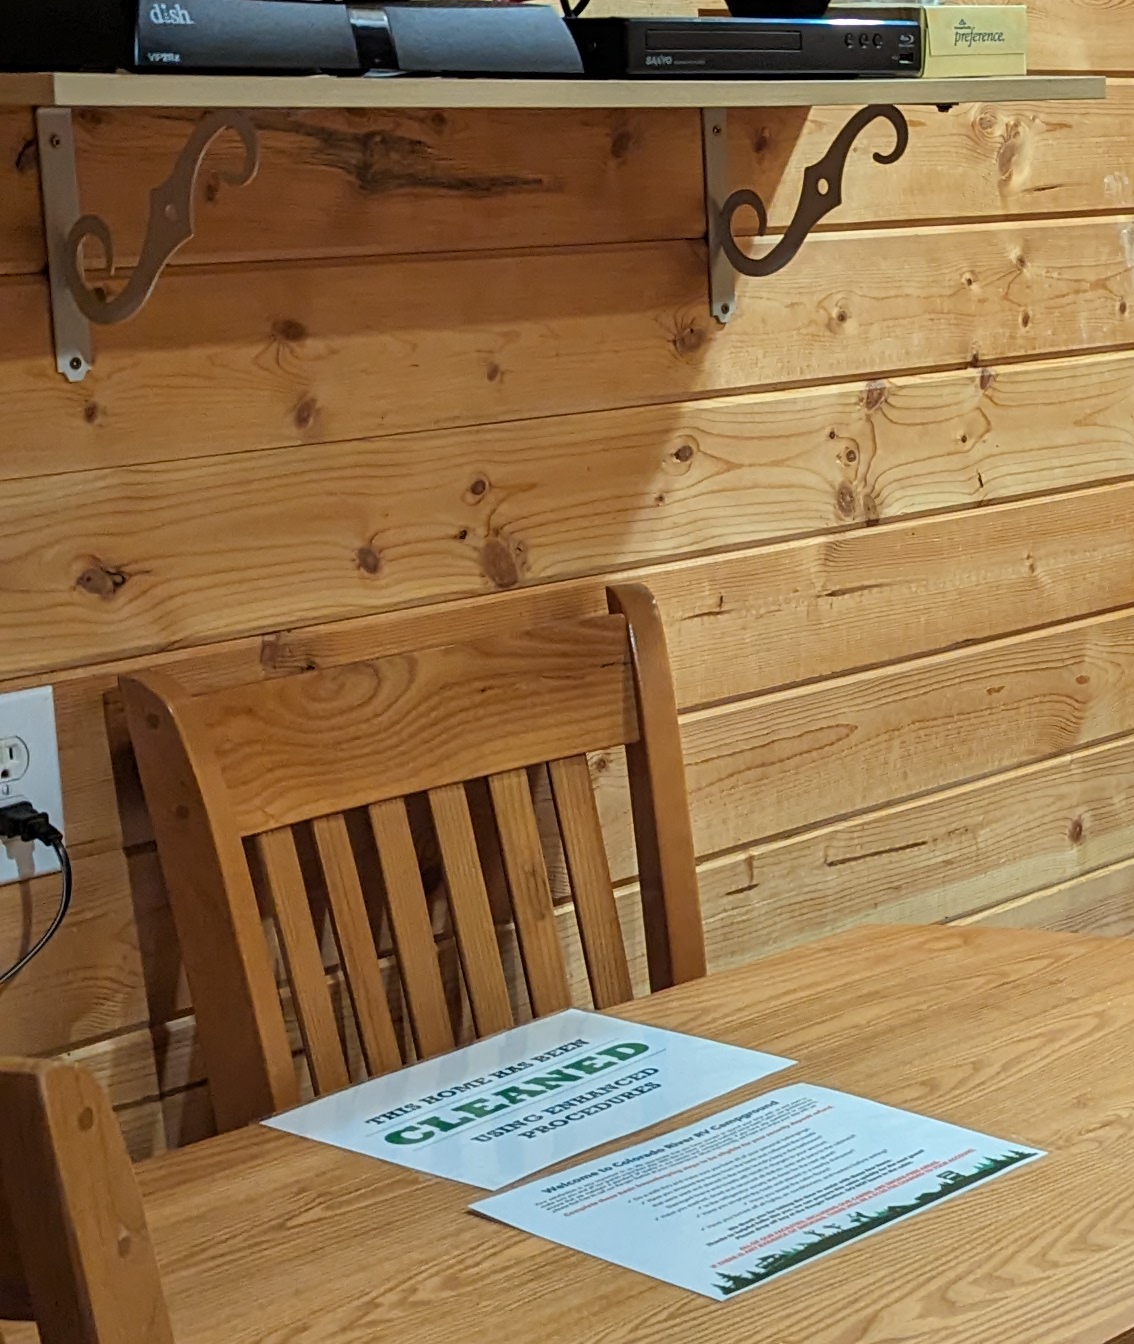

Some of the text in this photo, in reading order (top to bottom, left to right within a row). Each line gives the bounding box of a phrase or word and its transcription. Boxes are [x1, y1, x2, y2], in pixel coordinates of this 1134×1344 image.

[150, 2, 195, 25] dish
[364, 1038, 590, 1126] THIS HOME HAS BEEN
[384, 1042, 650, 1145] CLEANED
[471, 1067, 660, 1144] USING ENHANCED
[517, 1081, 662, 1140] PROCEDURES
[541, 1167, 598, 1194] Welcome
[598, 1164, 613, 1174] to
[612, 1146, 665, 1169] Colorado
[663, 1135, 695, 1150] River
[694, 1127, 711, 1139] RV
[710, 1100, 780, 1133] Campground
